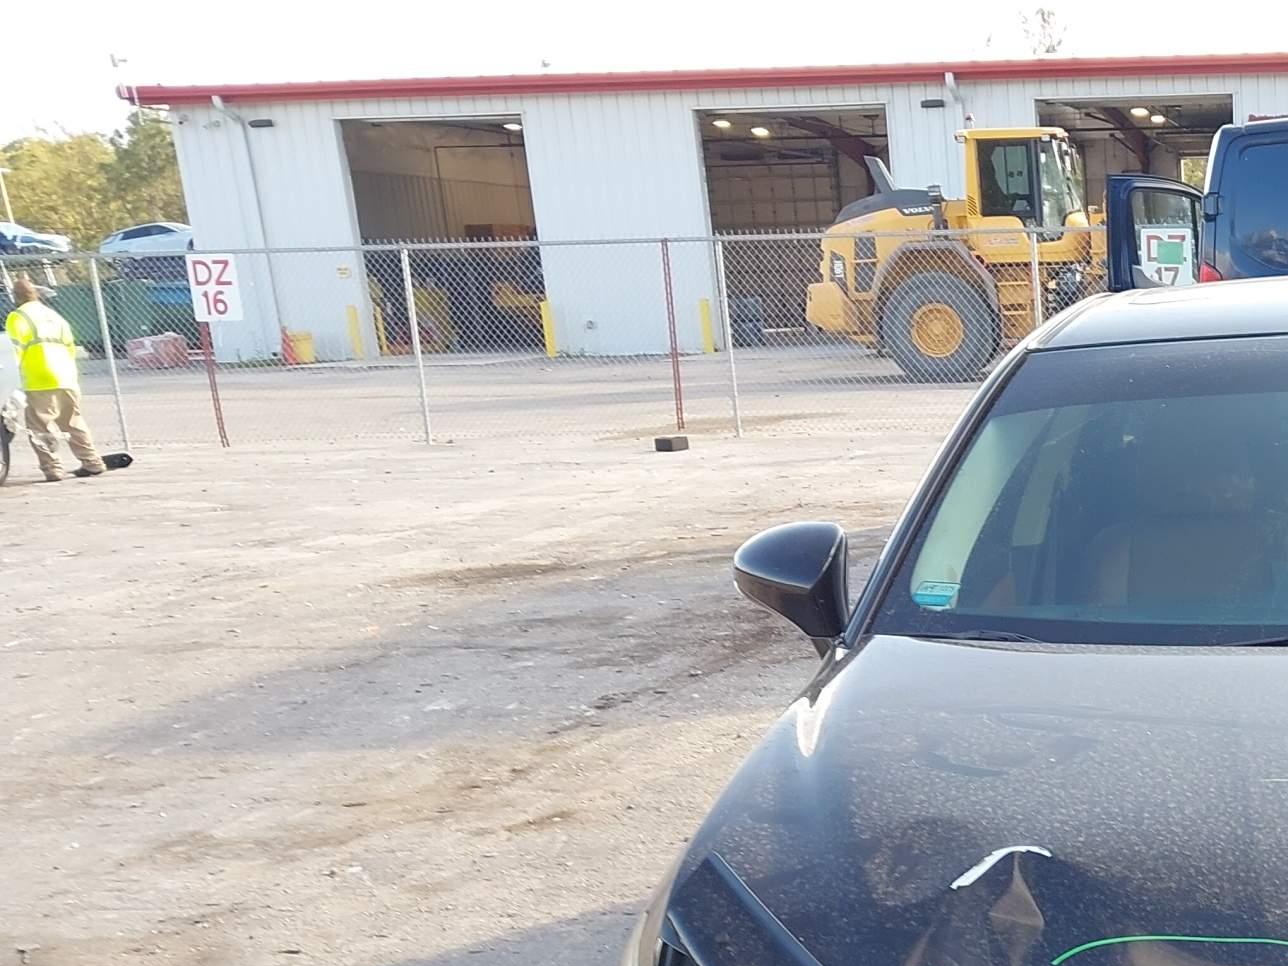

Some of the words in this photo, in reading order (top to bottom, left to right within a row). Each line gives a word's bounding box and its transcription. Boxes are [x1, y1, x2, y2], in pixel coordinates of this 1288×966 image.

[902, 206, 935, 214] VOLV
[192, 260, 232, 286] DZ
[201, 290, 228, 315] 16
